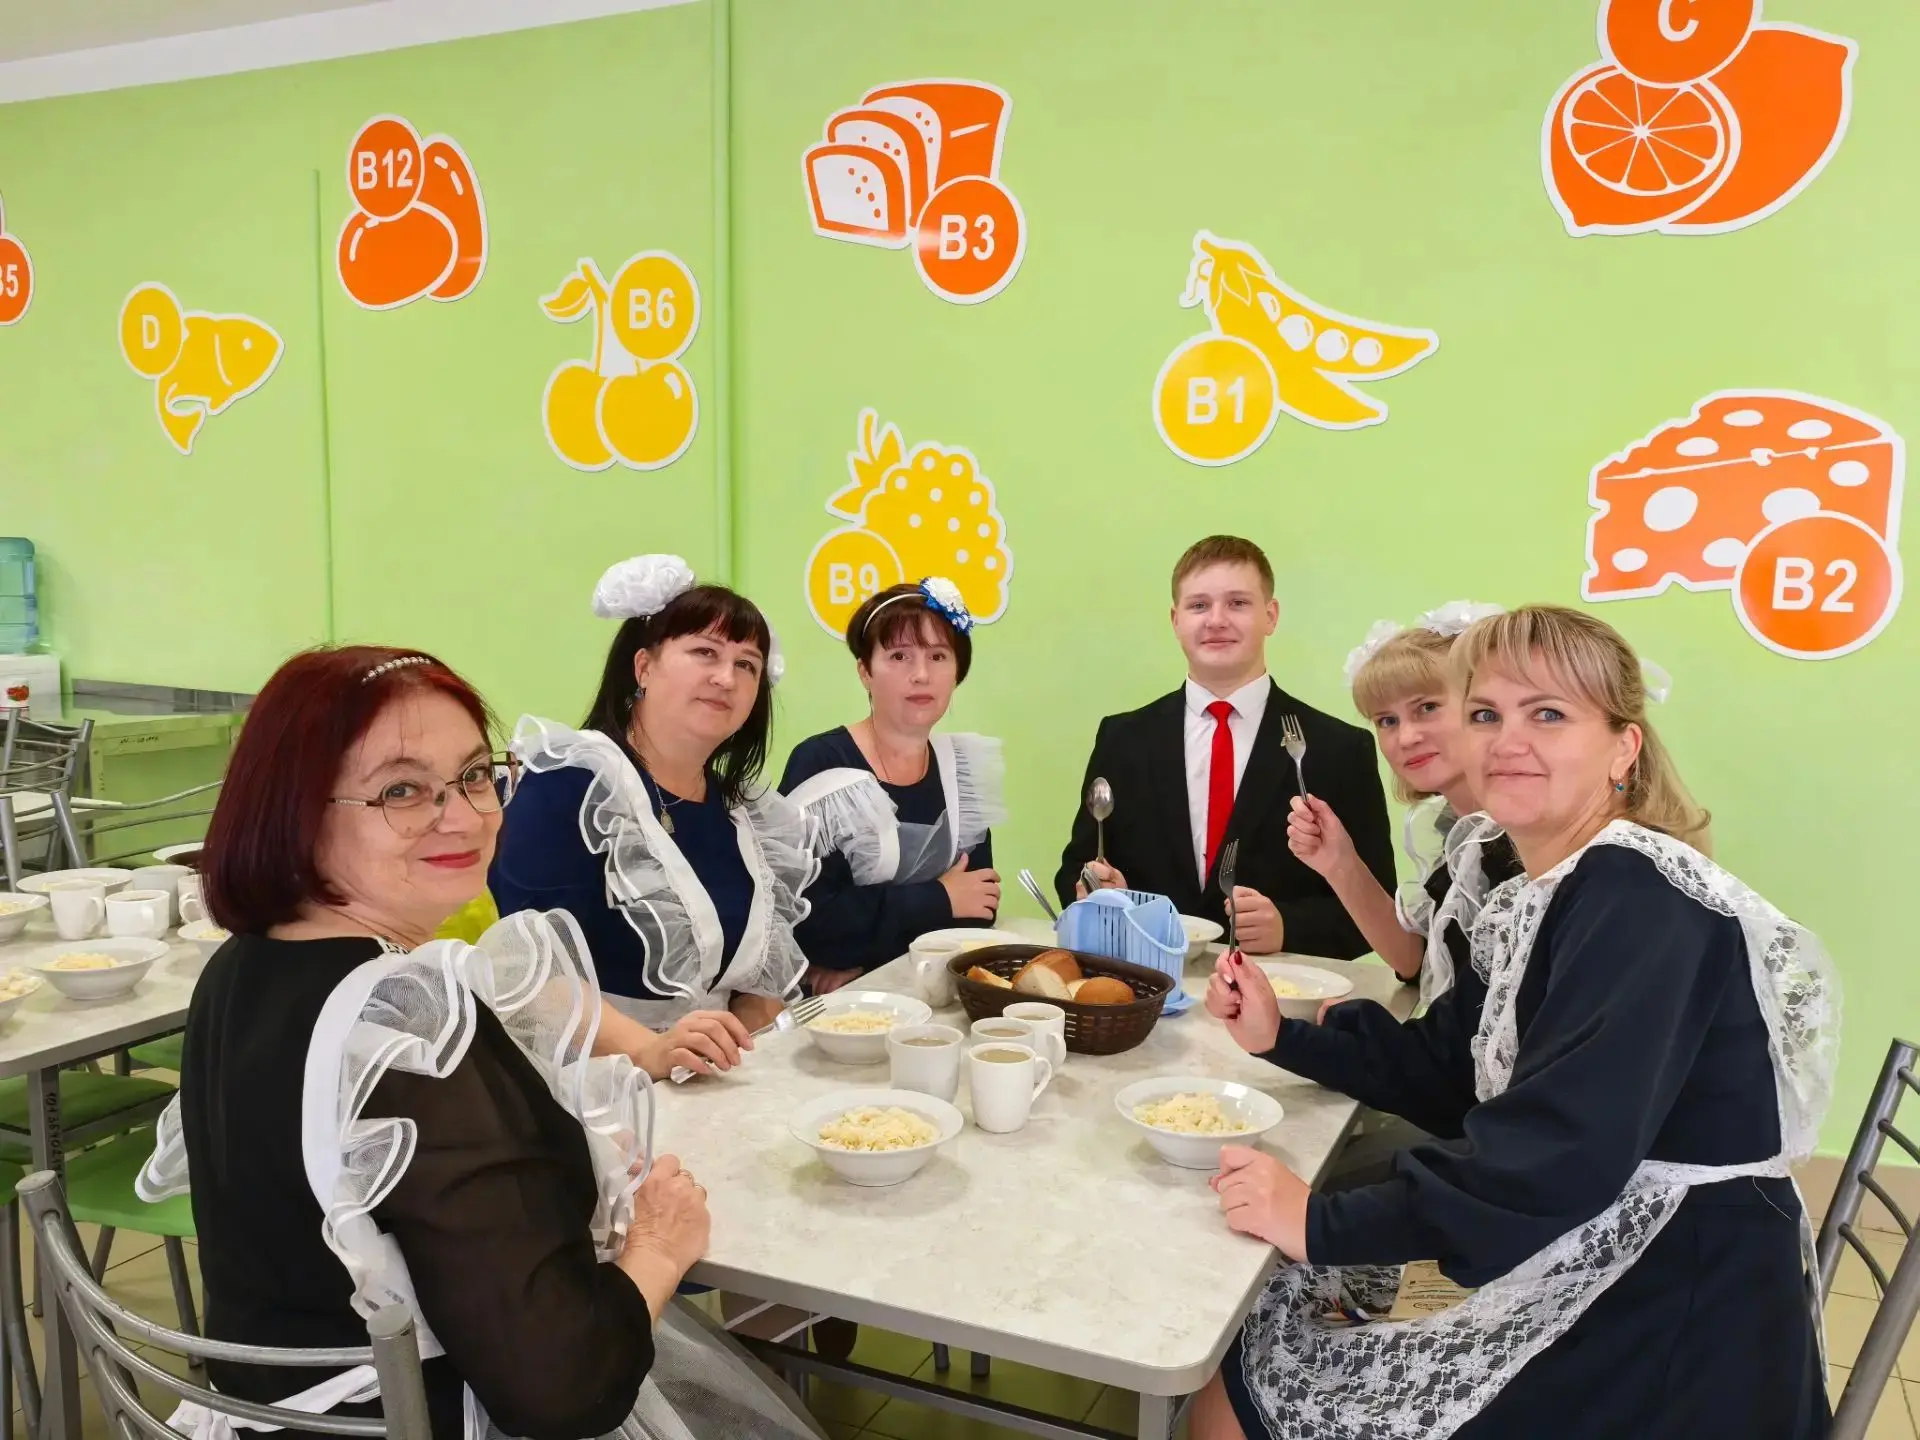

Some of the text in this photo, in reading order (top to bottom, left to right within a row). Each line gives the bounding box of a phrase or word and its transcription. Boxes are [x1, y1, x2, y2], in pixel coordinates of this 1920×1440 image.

[1658, 0, 1699, 42] C
[356, 148, 413, 190] B12
[938, 213, 996, 261] B3
[0, 263, 19, 298] 5
[628, 287, 676, 329] B6
[141, 314, 160, 349] D
[1186, 375, 1247, 425] B1
[829, 563, 880, 604] B9
[1770, 555, 1859, 613] B2
